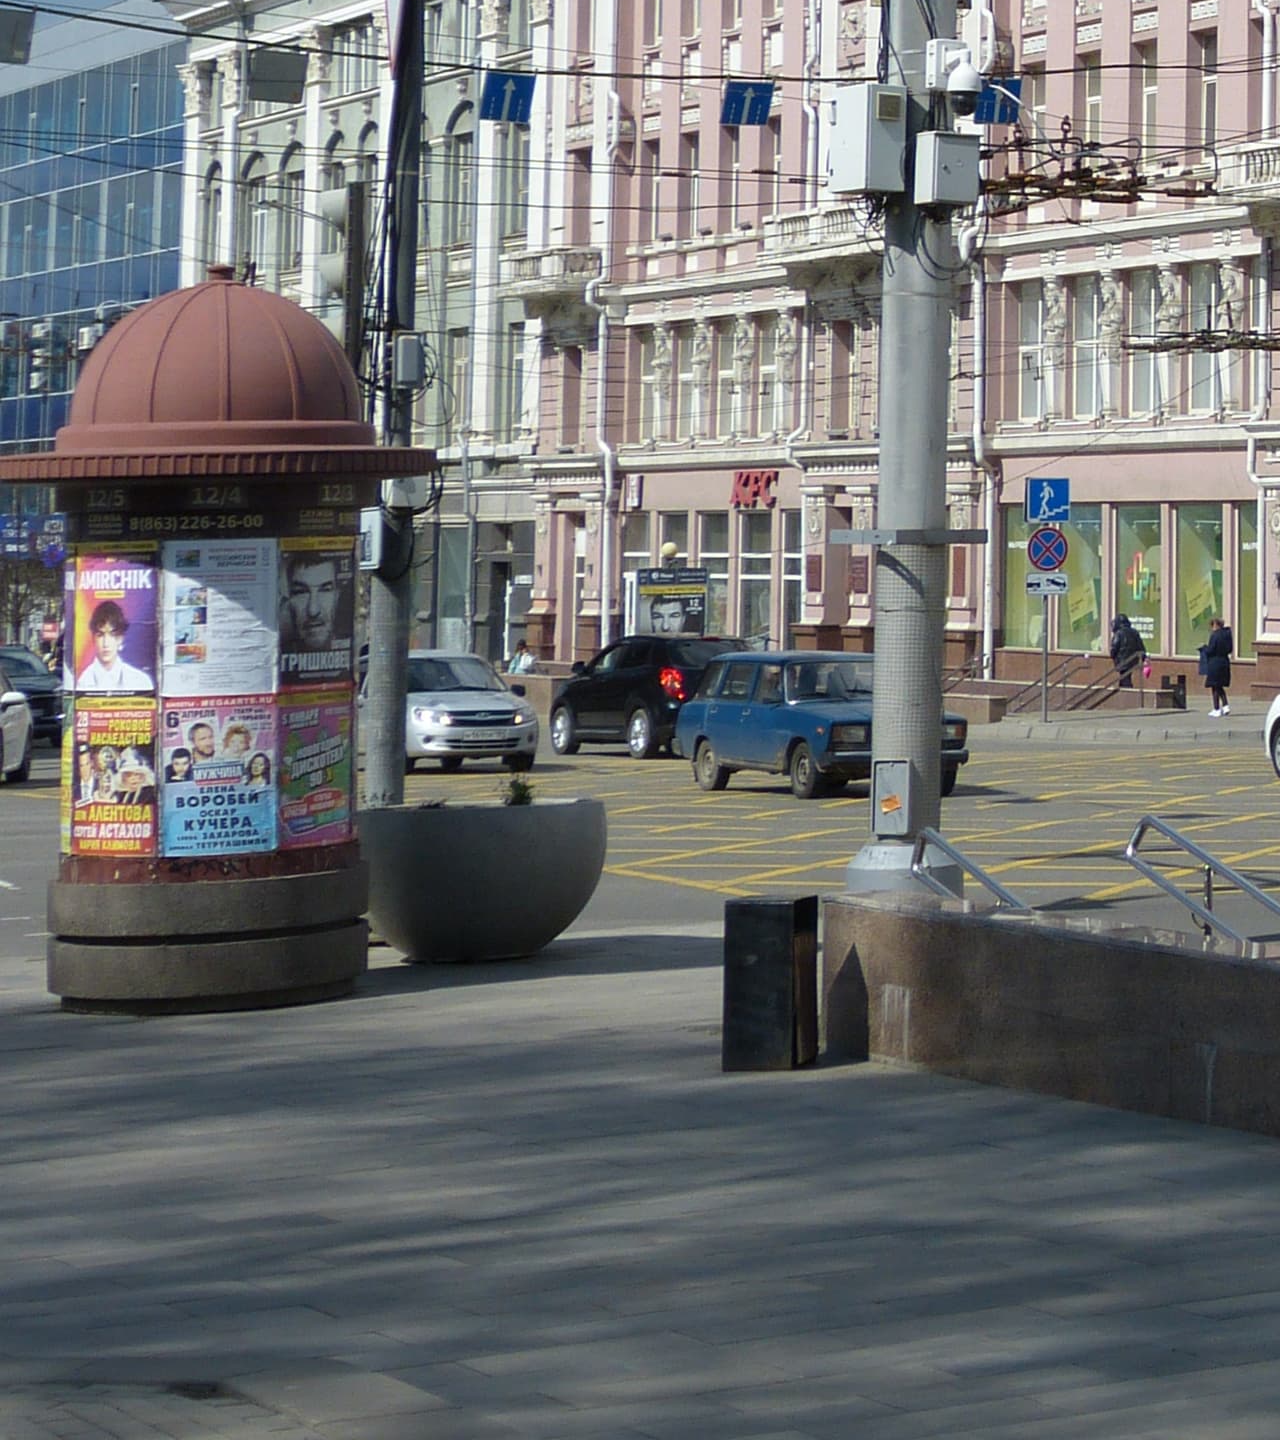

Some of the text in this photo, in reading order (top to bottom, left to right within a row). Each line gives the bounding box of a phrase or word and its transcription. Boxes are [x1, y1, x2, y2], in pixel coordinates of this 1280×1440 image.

[191, 486, 242, 505] 12/4
[730, 471, 778, 506] KFC
[87, 489, 125, 507] 12/5
[129, 516, 178, 532] 8(863)
[180, 514, 264, 531] 226-26-00
[78, 568, 153, 590] AMIRCHIK
[280, 651, 350, 671] ГРИШКОВЕЦ
[108, 719, 152, 731] РОКОВОЕ
[166, 711, 179, 728] 6
[90, 732, 151, 746] НАСЛЕДСТВО
[200, 785, 235, 794] ЕЛЕНА
[176, 789, 259, 808] ВОРОБЕЙ
[88, 805, 151, 821] АЛЕНТОВА
[200, 809, 237, 818] ОСКАР
[98, 823, 151, 838] АСТАХОВ
[184, 816, 253, 832] КУЧЕРА
[202, 829, 260, 840] ЗАХАРОВА
